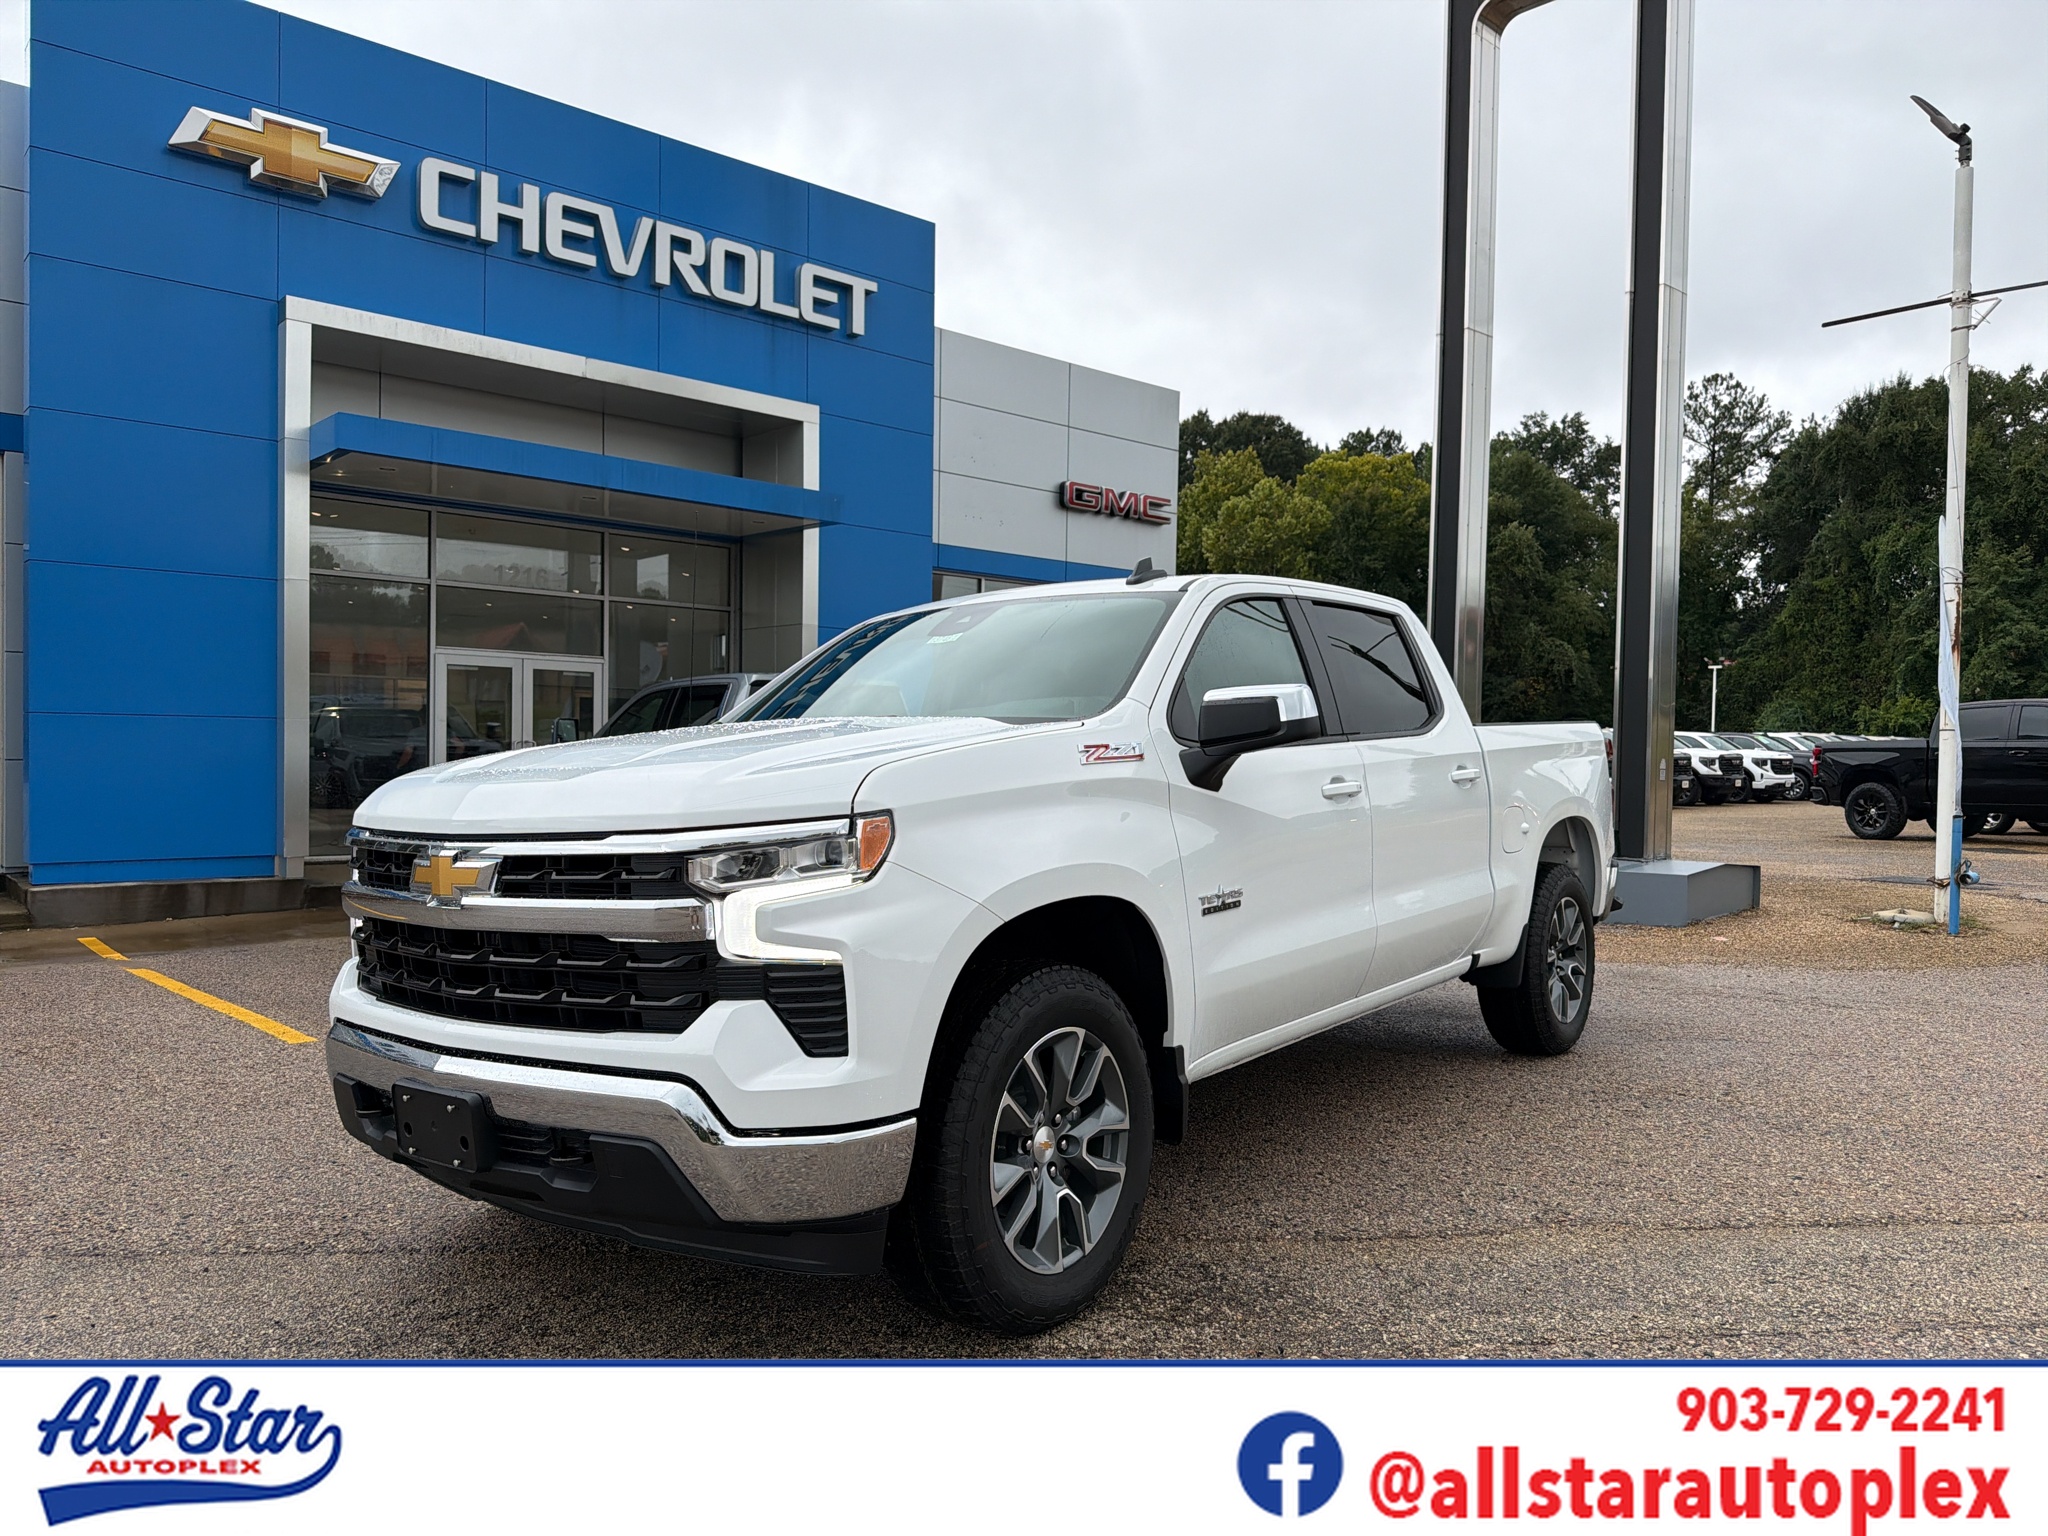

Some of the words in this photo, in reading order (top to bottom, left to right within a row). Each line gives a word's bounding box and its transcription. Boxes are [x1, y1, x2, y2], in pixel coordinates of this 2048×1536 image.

[417, 156, 878, 337] CHEVROLET
[1060, 480, 1172, 525] GMC
[494, 564, 548, 588] 1216
[1077, 742, 1145, 765] Z71
